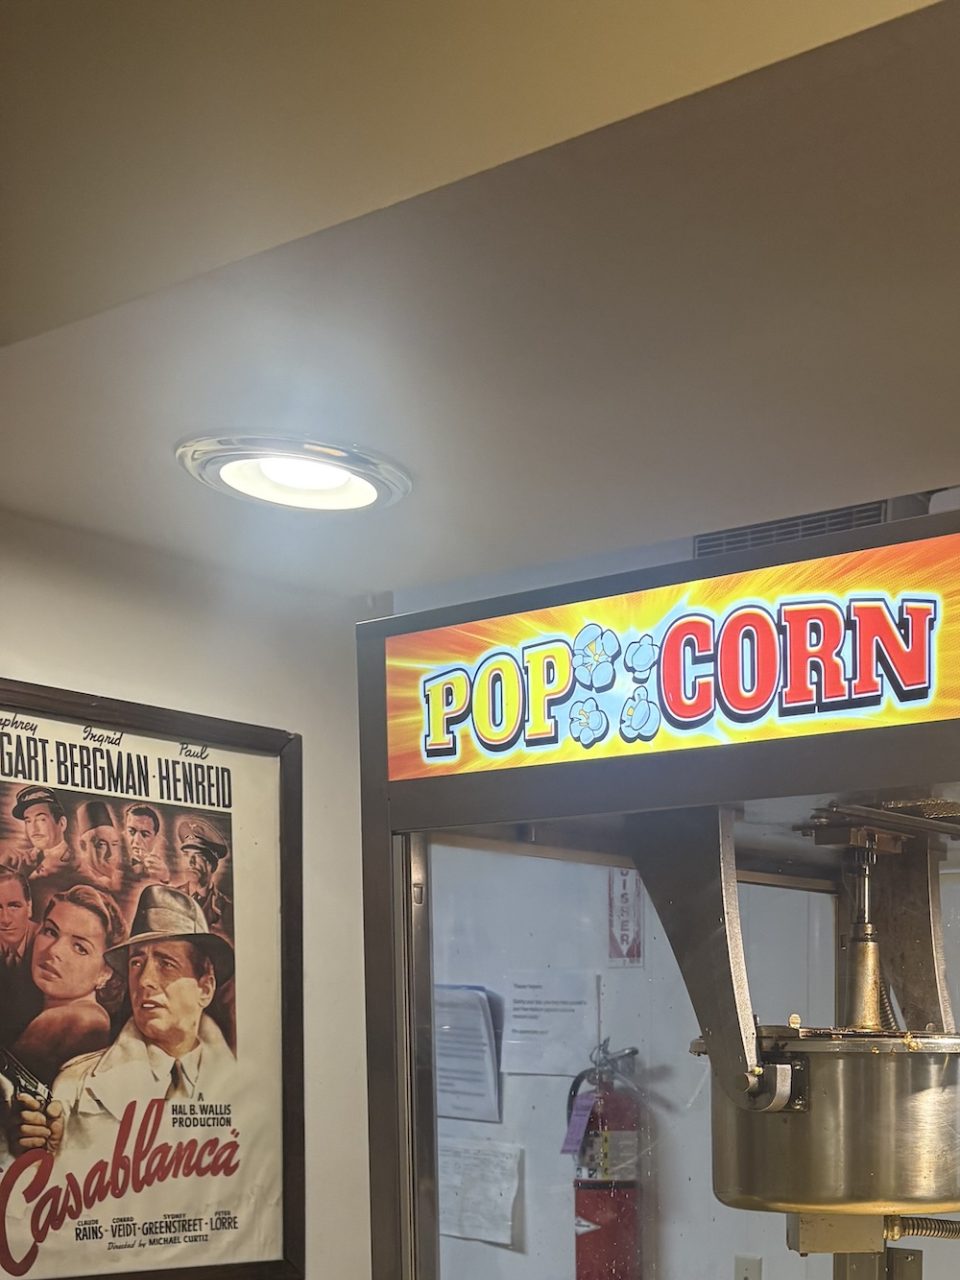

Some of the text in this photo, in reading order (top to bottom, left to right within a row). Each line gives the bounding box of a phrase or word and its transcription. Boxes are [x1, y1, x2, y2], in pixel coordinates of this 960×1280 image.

[422, 593, 937, 758] POP CORN
[83, 724, 123, 747] Ingrid
[179, 742, 209, 760] Paul
[0, 731, 232, 809] GART BERGMAN HENREID
[171, 1104, 232, 1115] HAL B. WALLIS
[172, 1116, 232, 1128] PRODUCTION
[75, 1216, 238, 1241] RAINS VEIDT GREENSTREET LORRE
[148, 1236, 181, 1246] MICHAEL
